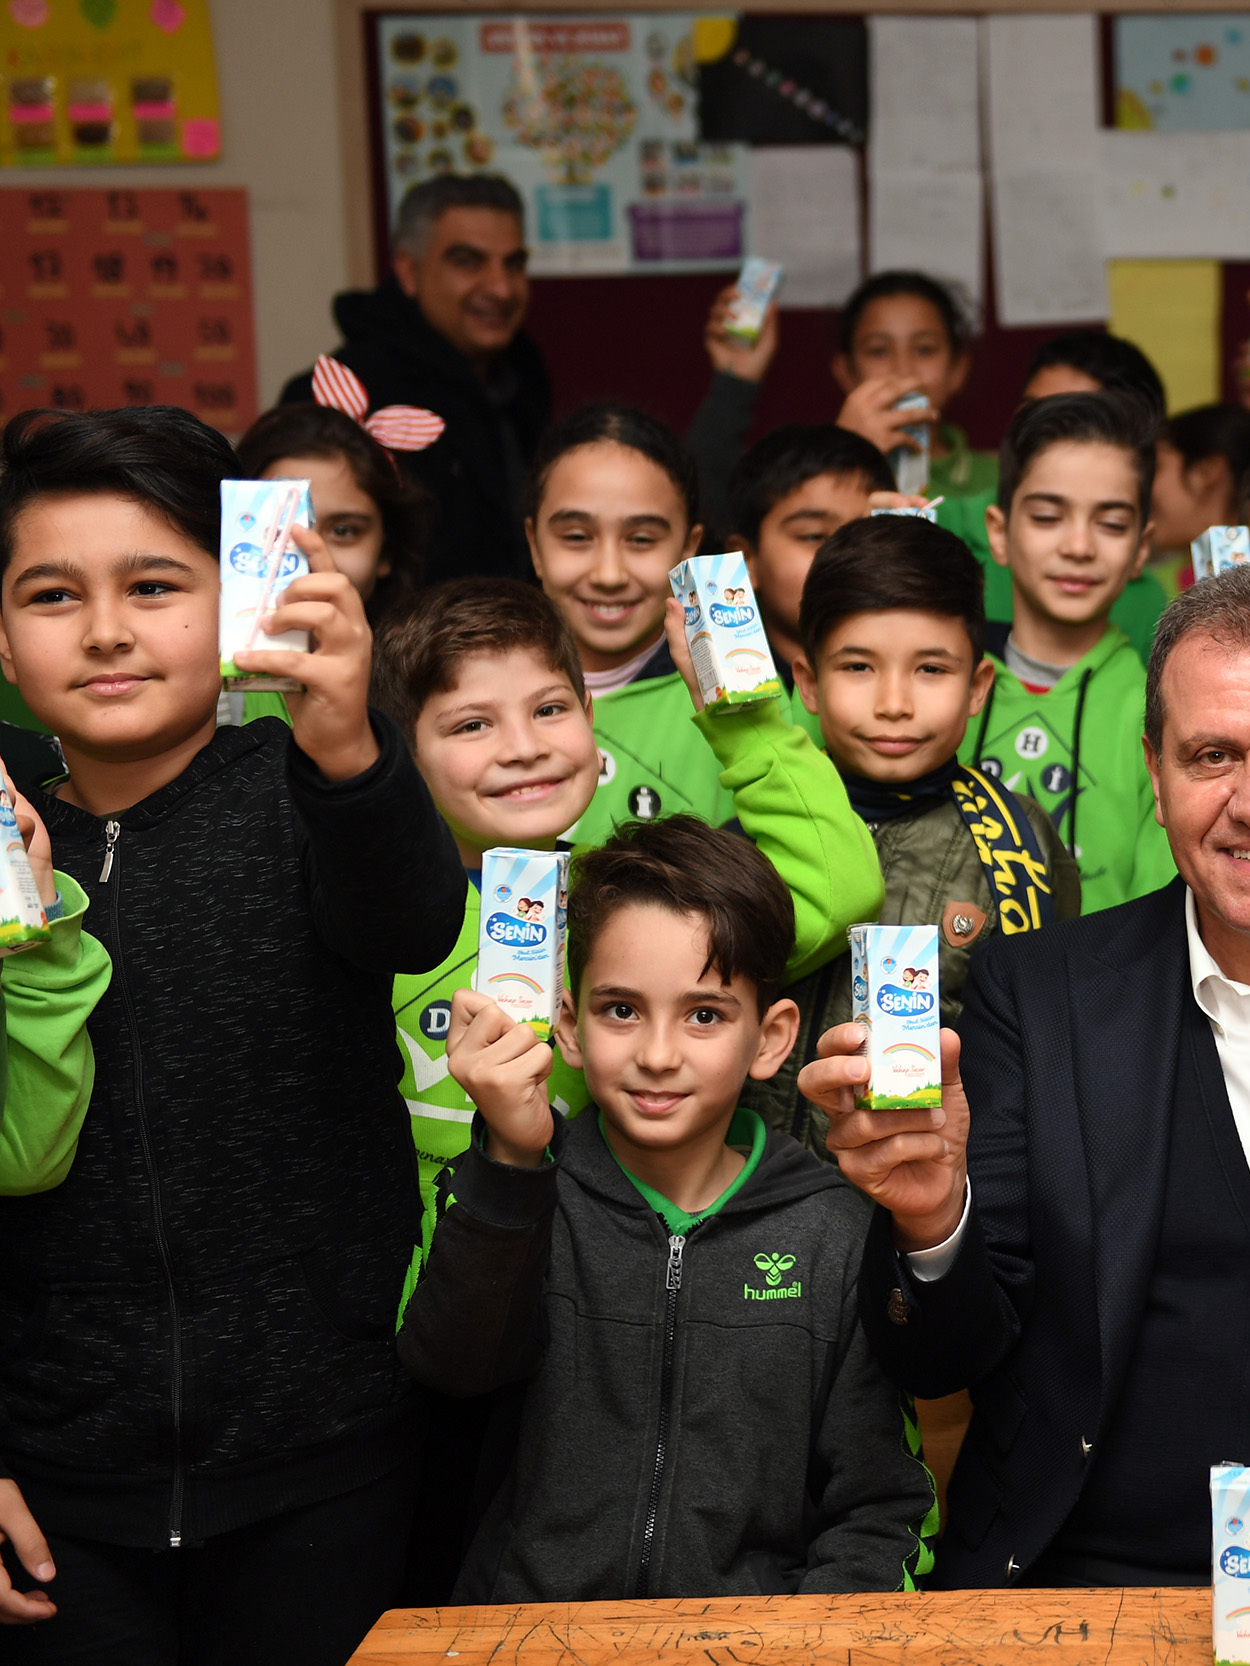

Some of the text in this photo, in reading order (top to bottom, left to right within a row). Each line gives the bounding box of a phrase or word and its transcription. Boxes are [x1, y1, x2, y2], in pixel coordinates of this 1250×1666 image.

[234, 551, 296, 573] SEN
[714, 607, 753, 626] SENİN
[491, 922, 544, 943] SENİN
[881, 992, 931, 1013] SENİN
[427, 1007, 451, 1033] D
[744, 1282, 802, 1300] hummel
